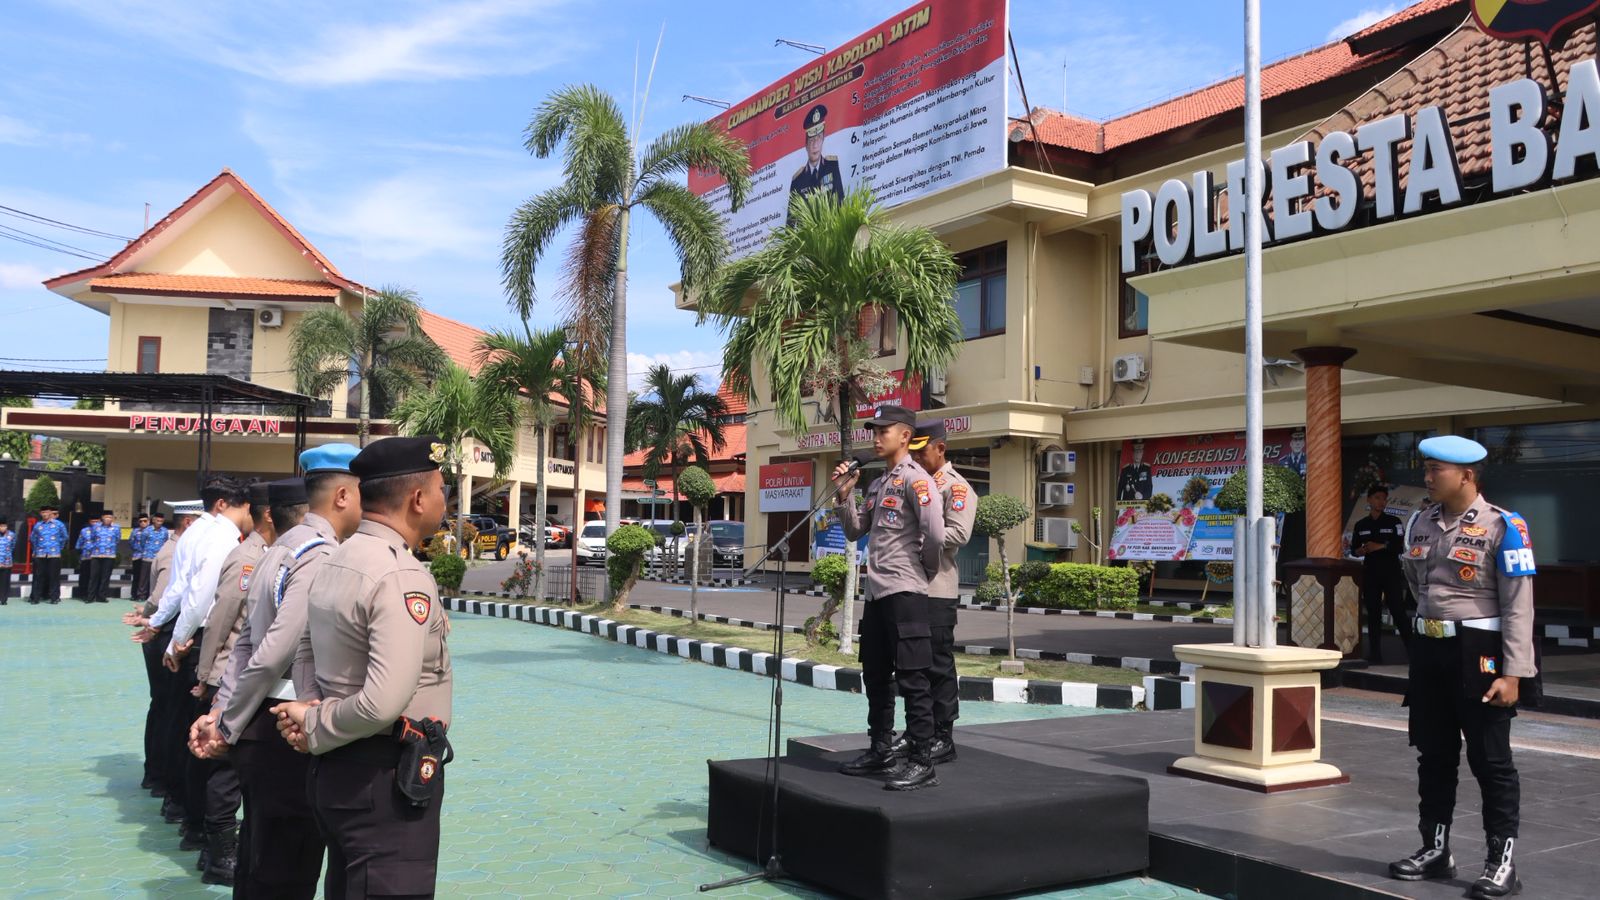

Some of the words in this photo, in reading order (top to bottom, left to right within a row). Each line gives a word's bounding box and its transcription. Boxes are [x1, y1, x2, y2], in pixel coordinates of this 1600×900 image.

[728, 84, 790, 130] COMMANDER
[794, 64, 824, 94] WISH
[826, 32, 884, 74] KAPOLDA
[888, 6, 931, 45] JATIM
[852, 92, 860, 105] 5.
[890, 111, 914, 126] Humanis
[914, 100, 936, 115] dengan
[936, 84, 974, 104] Membangun
[974, 74, 996, 88] Kultur
[896, 94, 924, 112] Pelayanan
[926, 79, 961, 98] Masyarakat
[962, 72, 976, 84] yang
[893, 138, 912, 150] Semua
[912, 128, 932, 142] Elemen
[932, 112, 968, 132] Masyarakat
[970, 106, 987, 118] Mitra
[851, 132, 860, 144] 6.
[886, 153, 902, 164] dalam
[904, 142, 928, 156] Menjaga
[928, 128, 962, 146] Kamtibmas
[963, 122, 970, 133] di
[970, 118, 988, 130] Jawa
[928, 160, 950, 173] dengan
[964, 146, 985, 160] Pemda
[851, 164, 860, 178] 7.
[904, 179, 930, 194] Lembaga
[930, 170, 952, 183] Terkait.
[1121, 105, 1462, 274] POLRESTA
[129, 415, 280, 433] PENJAGAAN
[798, 433, 826, 448] SENTRA
[828, 428, 874, 446] PELANAN
[944, 416, 970, 433] PADU
[480, 451, 494, 463] SATS
[1154, 448, 1239, 464] KONFERENSI
[766, 477, 782, 488] POLRI
[784, 476, 805, 486] UNTUK
[1156, 468, 1202, 478] POLRESTA
[765, 488, 804, 500] MASYARAKAT
[1455, 536, 1486, 547] POLRI
